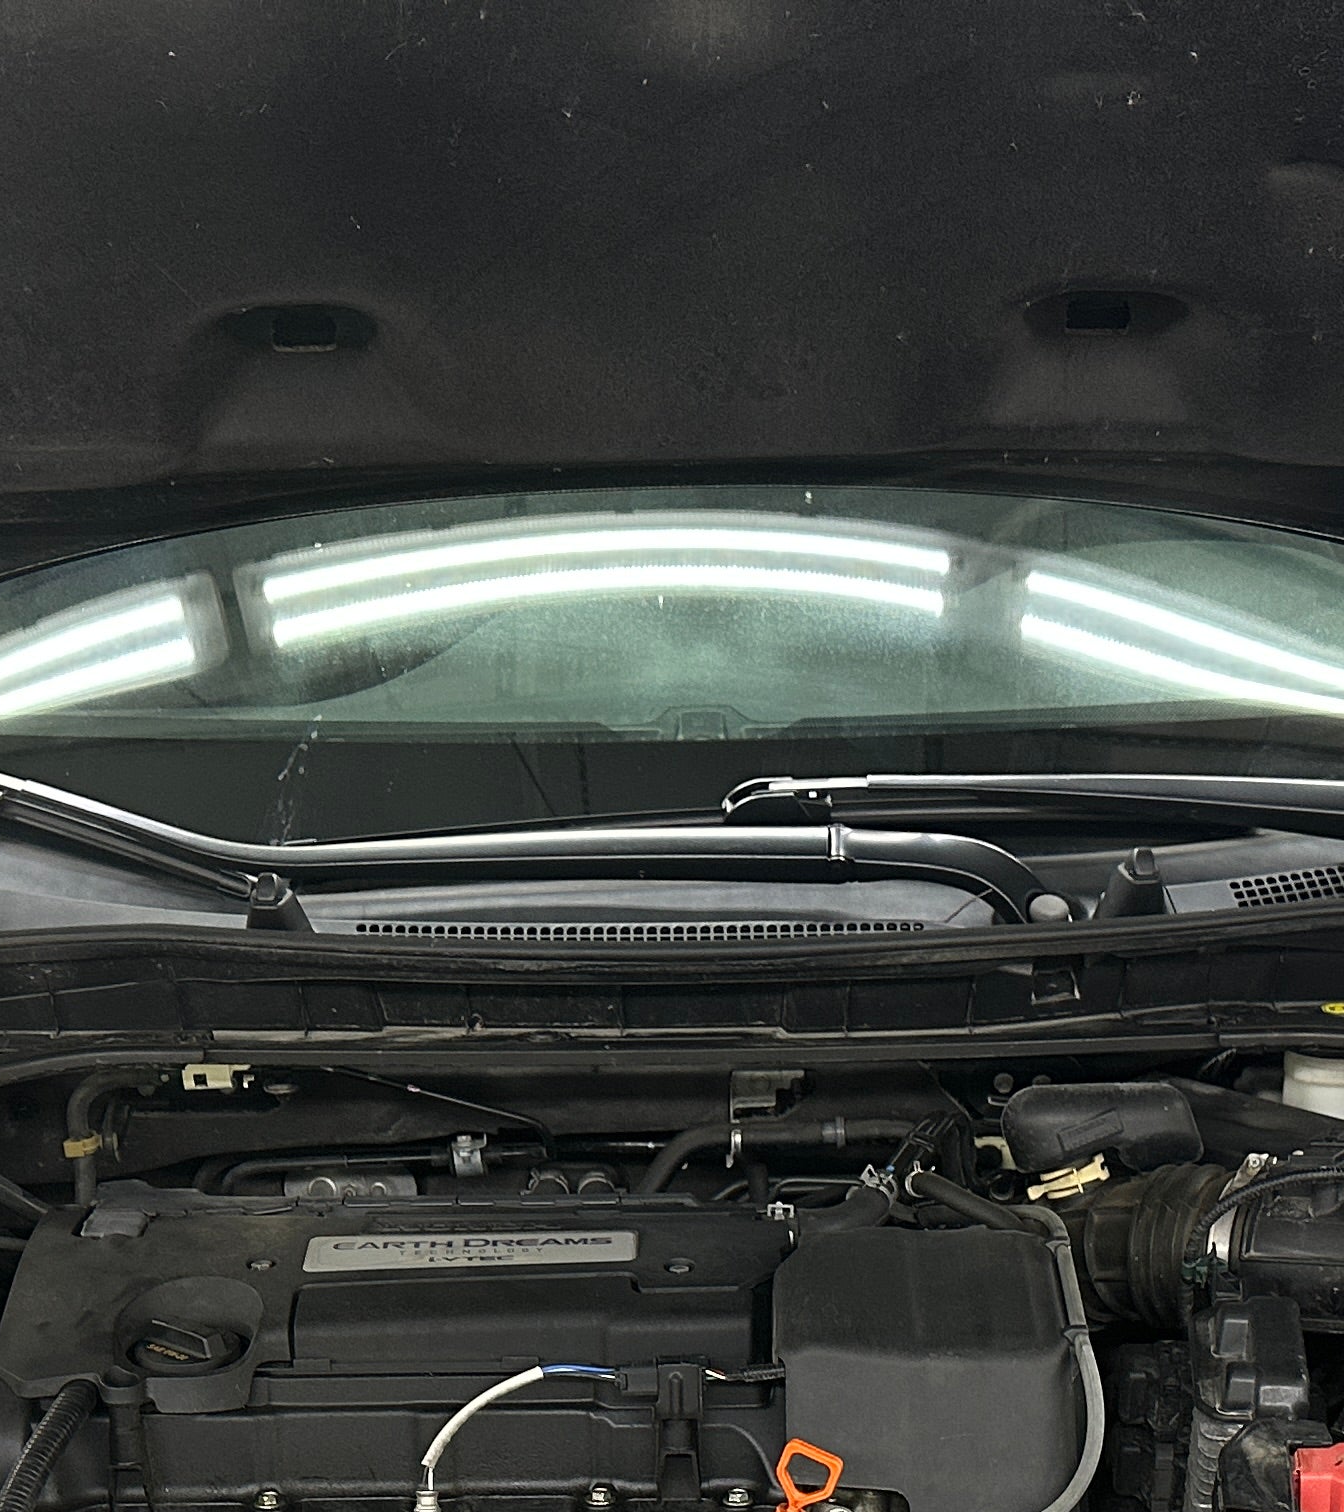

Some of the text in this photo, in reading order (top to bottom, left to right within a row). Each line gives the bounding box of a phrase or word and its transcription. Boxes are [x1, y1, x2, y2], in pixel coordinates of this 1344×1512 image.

[332, 1236, 613, 1251] EARTH DREAMS
[399, 1246, 544, 1256] TECHNOLOGY
